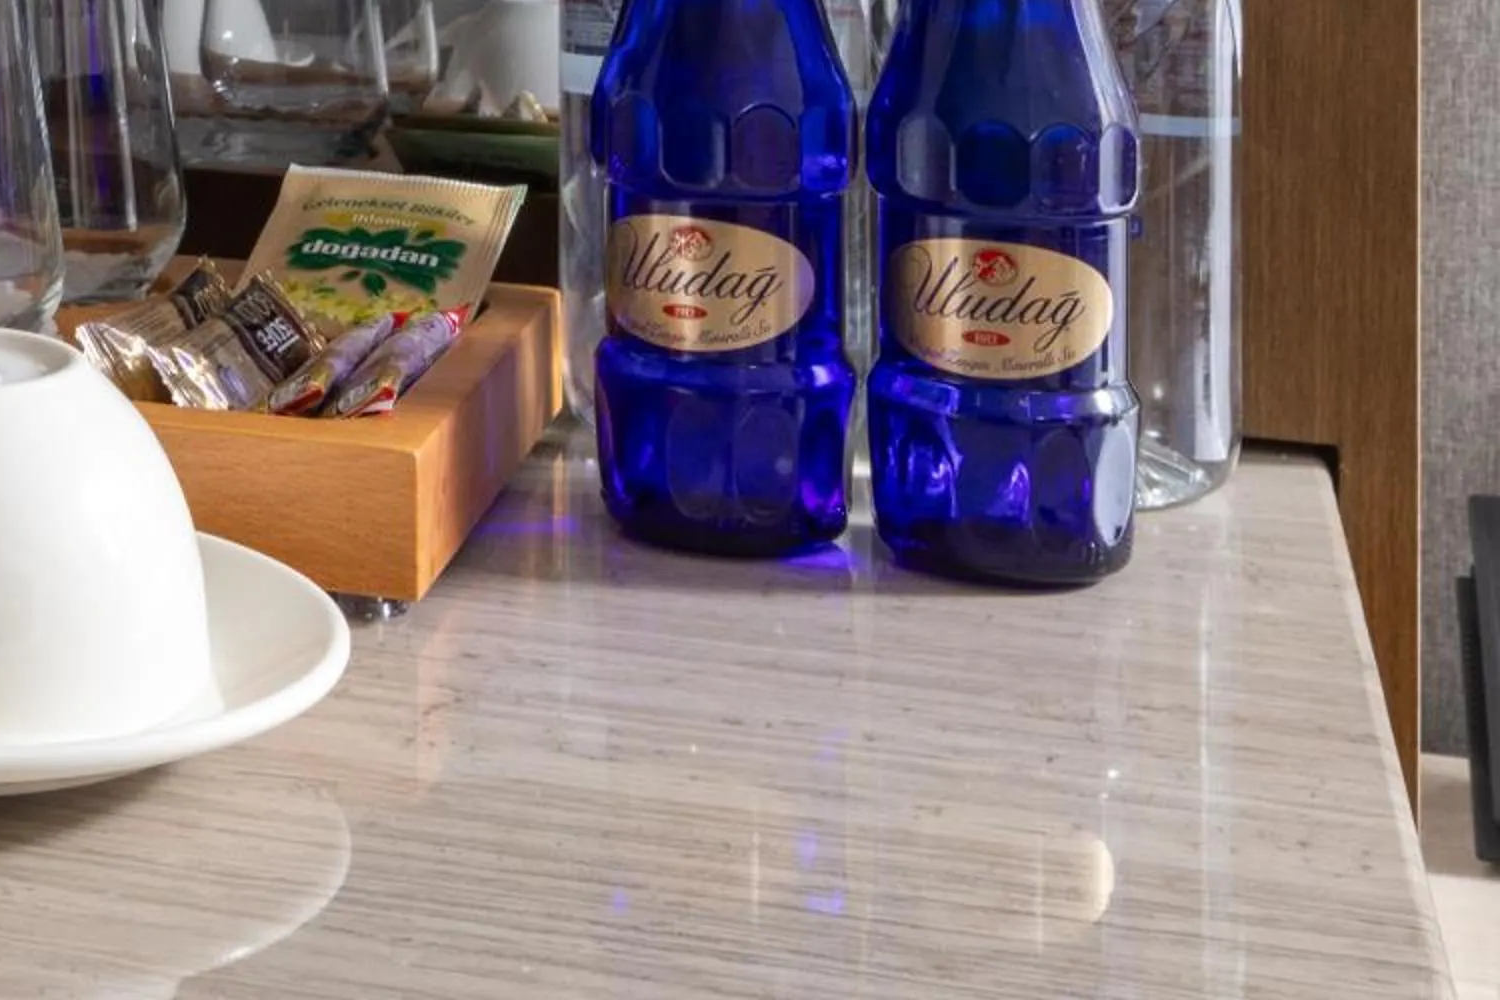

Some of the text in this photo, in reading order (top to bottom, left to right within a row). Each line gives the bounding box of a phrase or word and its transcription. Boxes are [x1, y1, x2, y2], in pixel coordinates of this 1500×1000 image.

[301, 238, 441, 267] doğadan
[613, 221, 784, 326] Uludağ
[902, 245, 1086, 351] Uludağ
